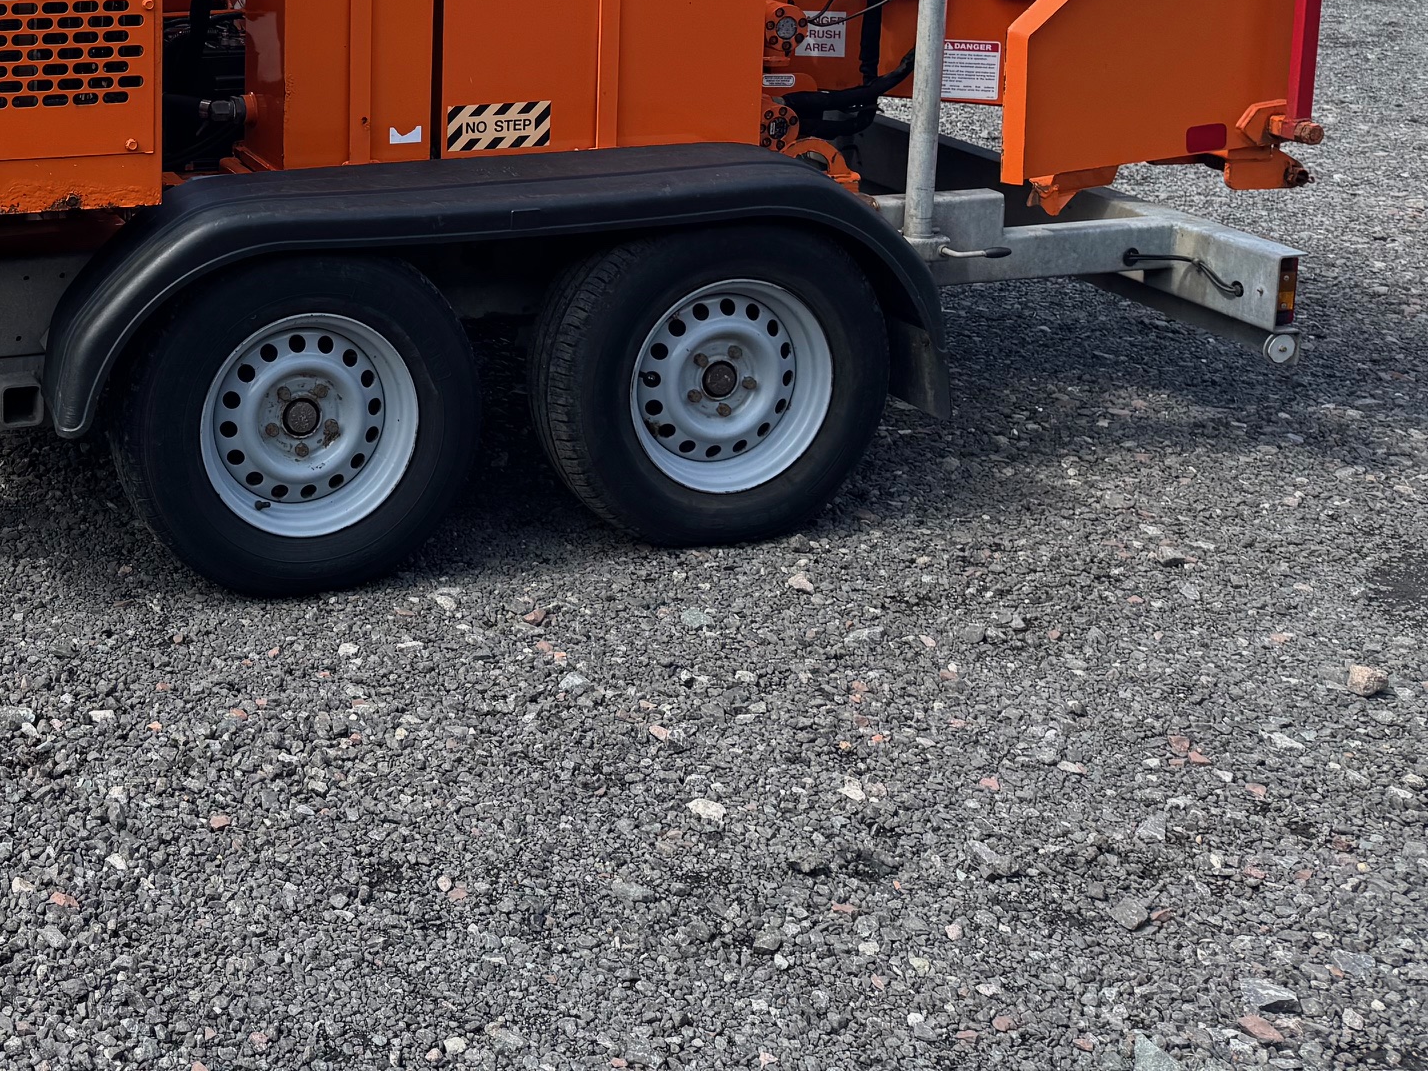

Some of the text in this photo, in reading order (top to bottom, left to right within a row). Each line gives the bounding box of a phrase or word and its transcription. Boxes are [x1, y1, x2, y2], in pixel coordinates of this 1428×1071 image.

[807, 30, 841, 39] RUSH
[804, 43, 836, 52] AREA
[954, 43, 992, 51] DANGER
[465, 119, 532, 134] NO STEP
